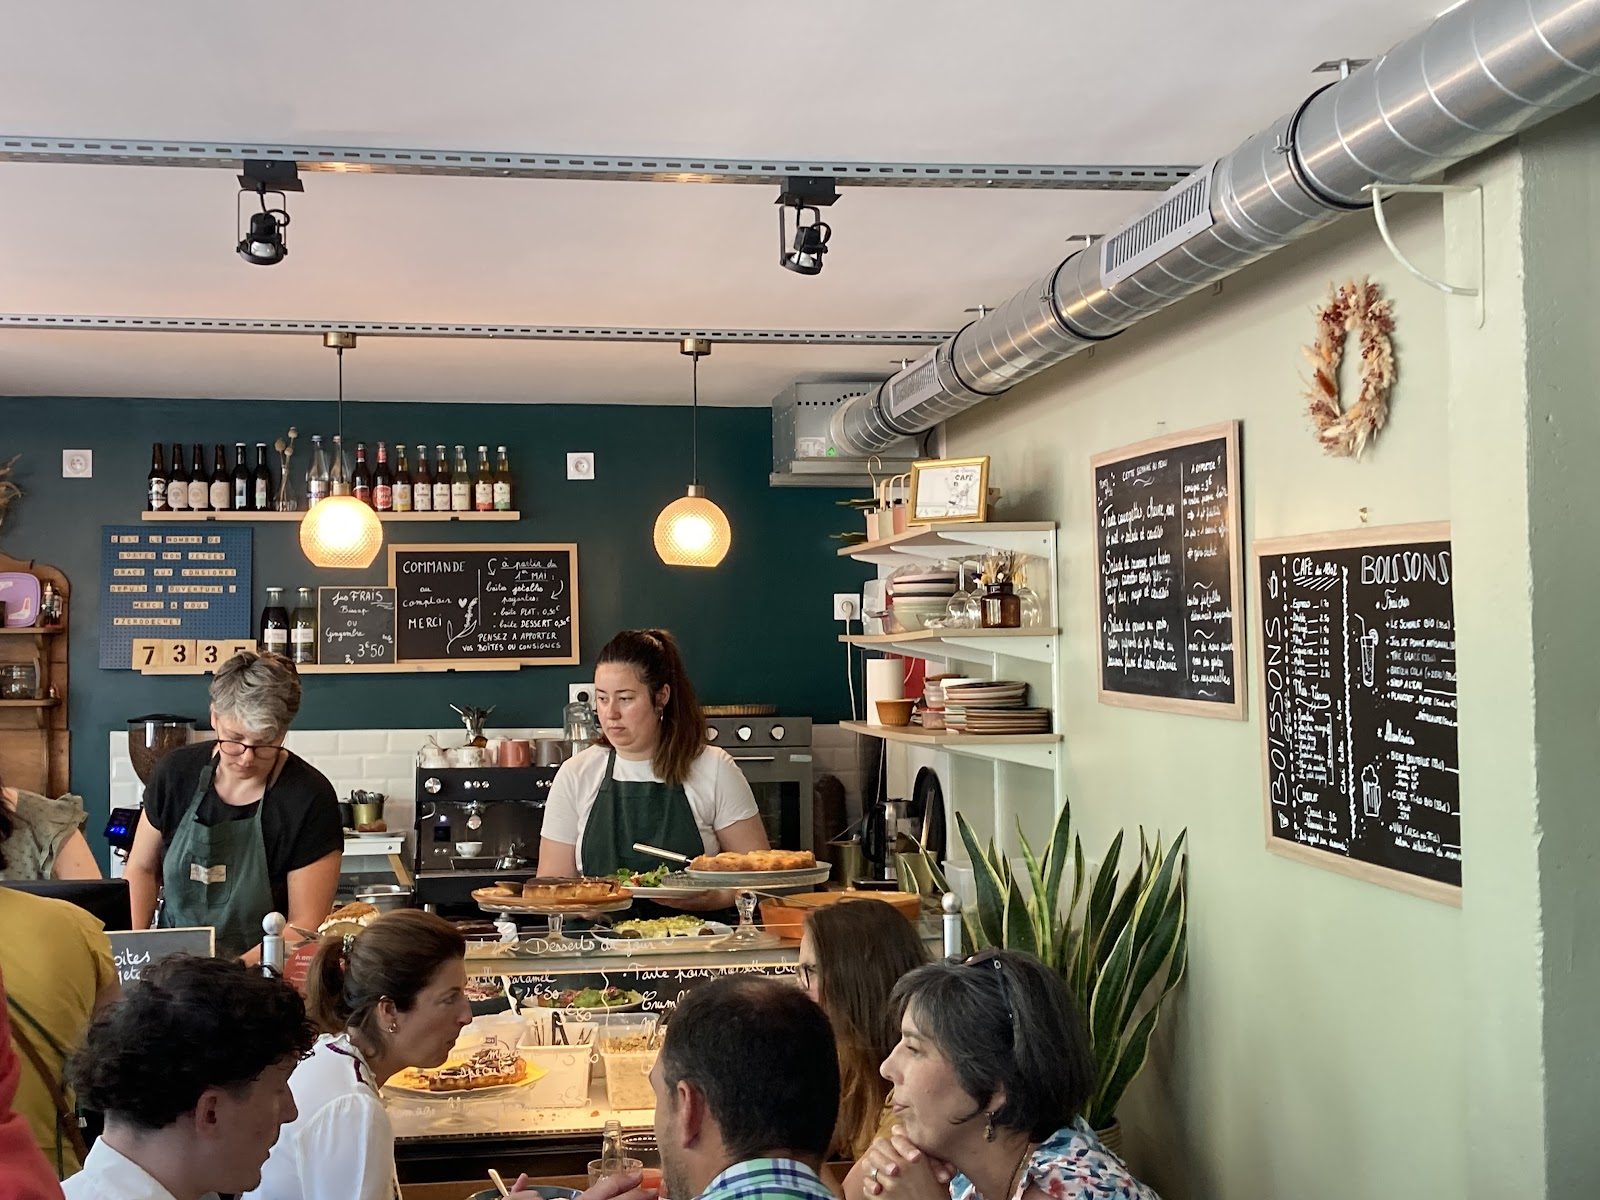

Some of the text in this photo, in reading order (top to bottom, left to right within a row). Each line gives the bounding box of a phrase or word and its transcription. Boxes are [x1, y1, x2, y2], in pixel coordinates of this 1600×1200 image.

[166, 536, 202, 544] NOMBRE
[403, 560, 466, 574] COMMANDE
[1361, 551, 1450, 586] BOISSONS
[520, 619, 552, 629] DESSERT
[478, 632, 508, 643] PENSEZ
[521, 632, 558, 641] APPORTER
[526, 936, 596, 955] Desserts
